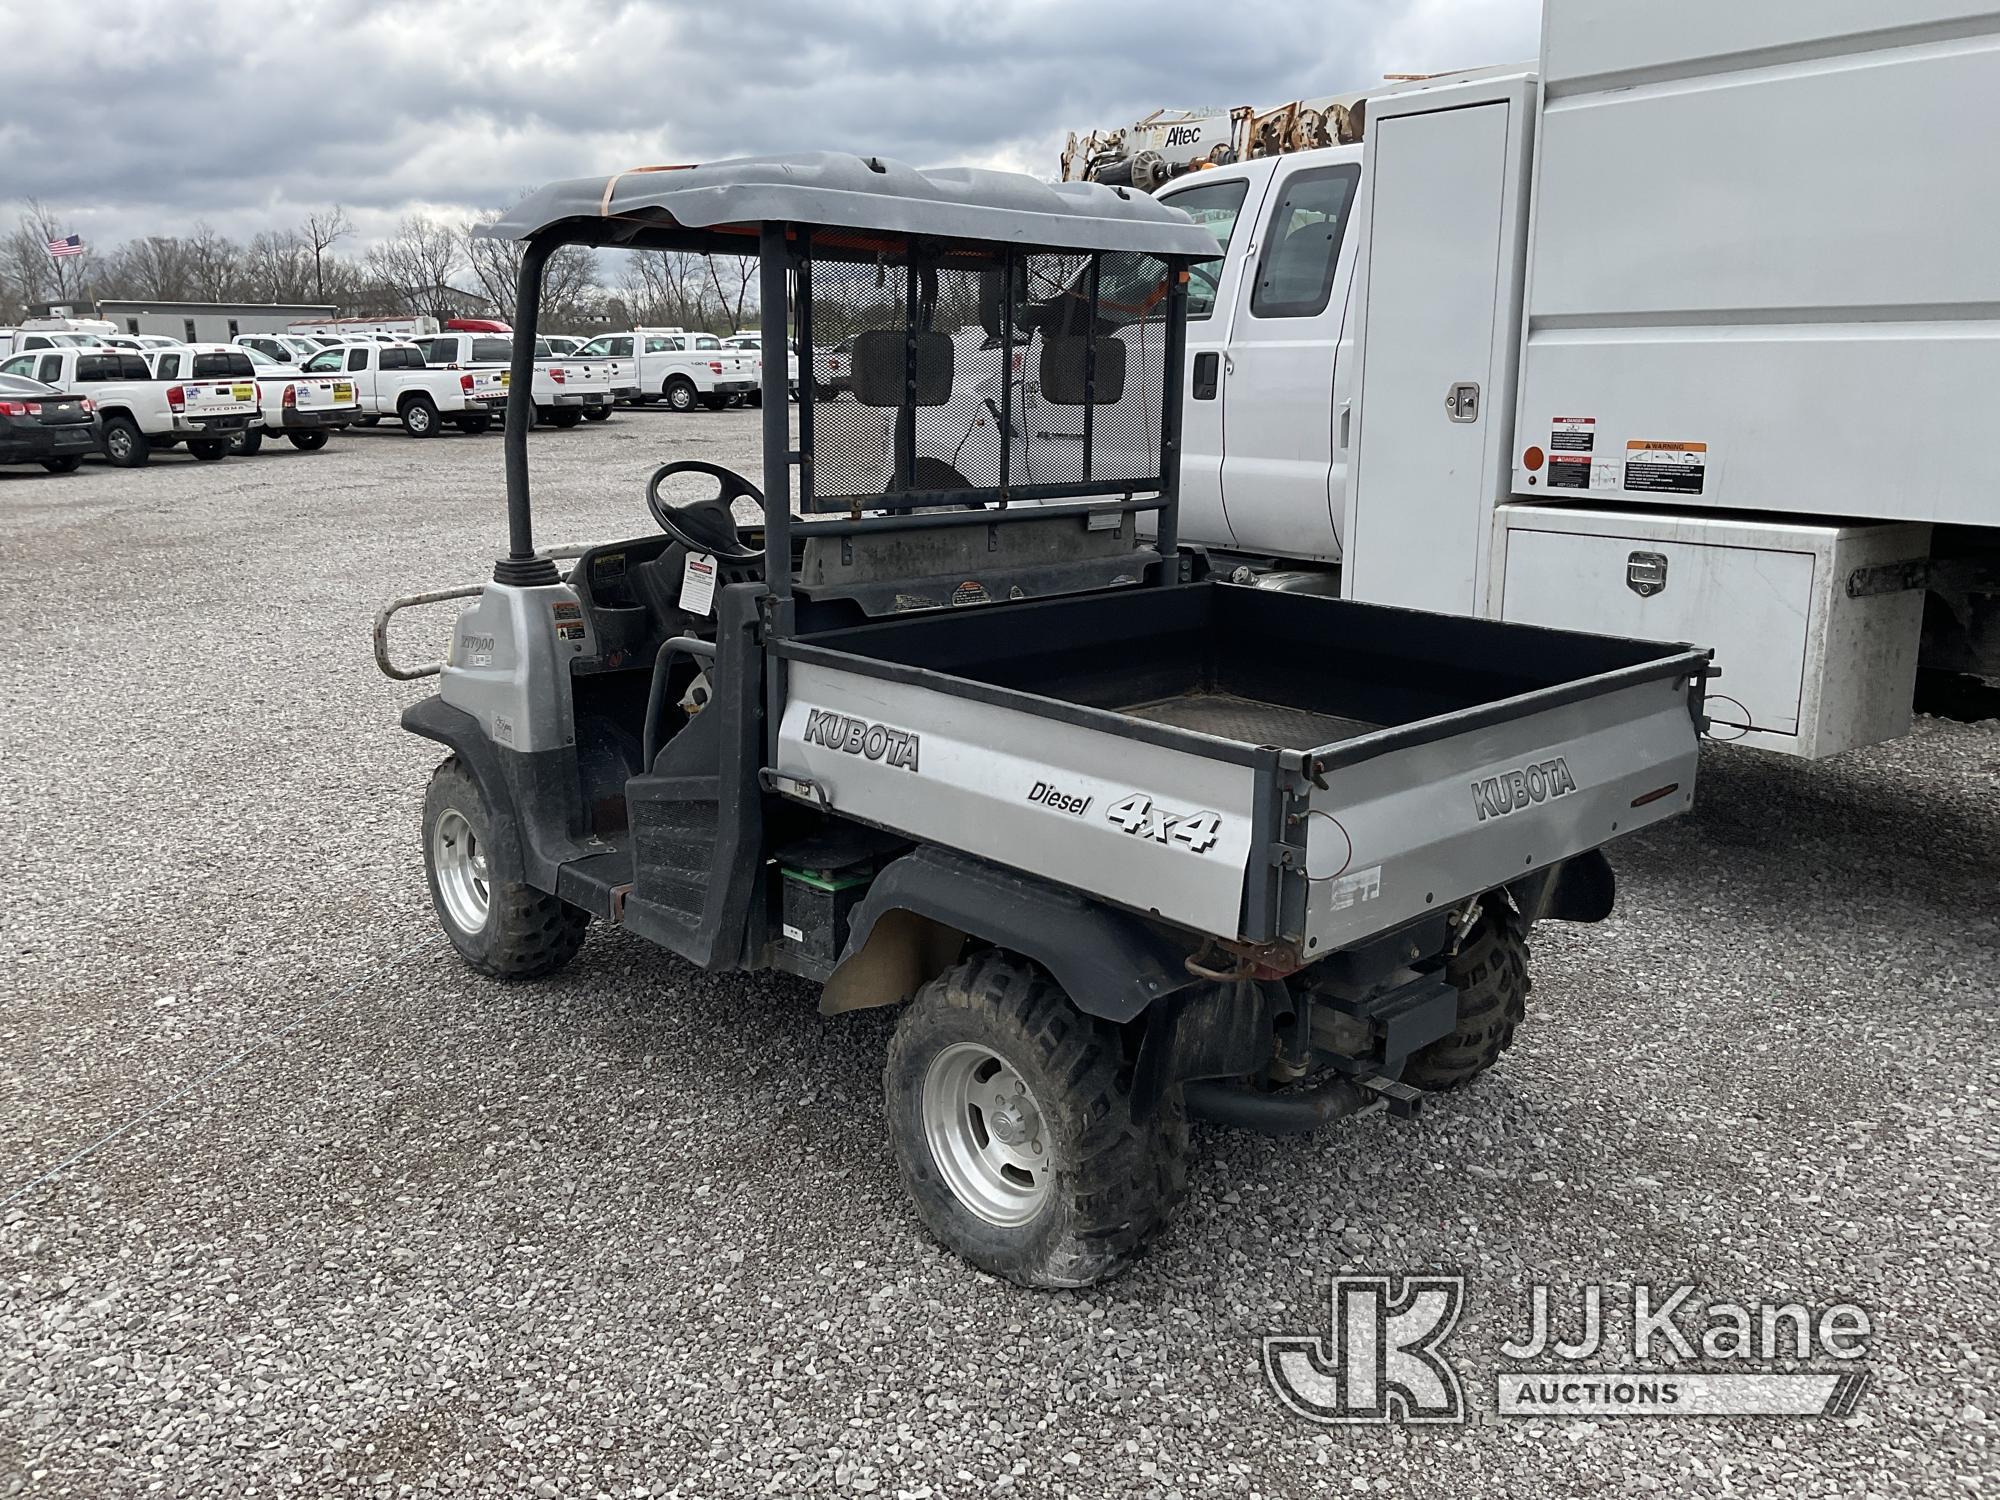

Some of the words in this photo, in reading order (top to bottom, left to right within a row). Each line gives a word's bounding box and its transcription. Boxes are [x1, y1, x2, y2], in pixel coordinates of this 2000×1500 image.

[1165, 126, 1201, 147] Altec
[803, 708, 920, 773] KUBOTA
[1028, 781, 1092, 816] Diesel
[1107, 793, 1222, 854] 4x4
[1471, 757, 1577, 821] KUBOTA
